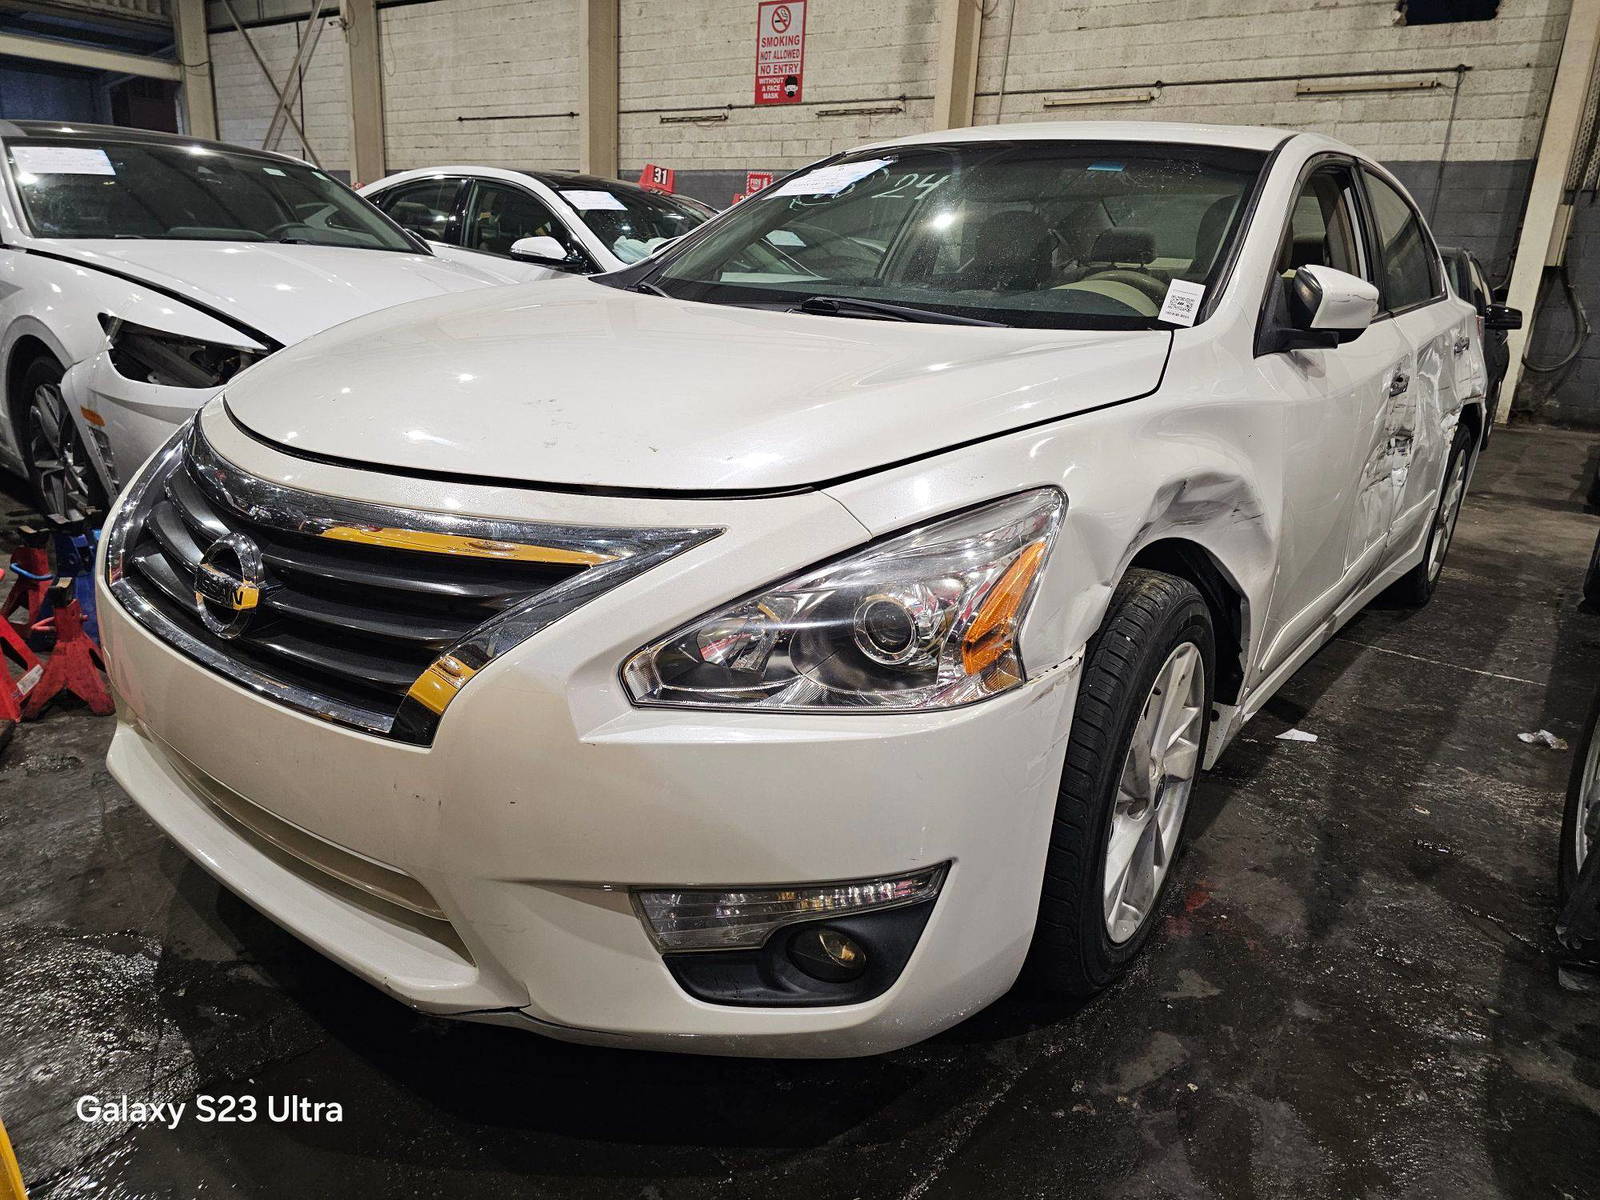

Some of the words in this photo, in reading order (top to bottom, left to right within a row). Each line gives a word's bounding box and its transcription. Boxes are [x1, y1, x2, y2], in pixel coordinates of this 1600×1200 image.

[761, 35, 800, 48] SMOKING
[760, 50, 771, 60] NOT
[773, 48, 800, 59] ALLOWED
[760, 64, 771, 74] NO
[773, 63, 799, 74] ENTRY
[653, 167, 667, 185] 31
